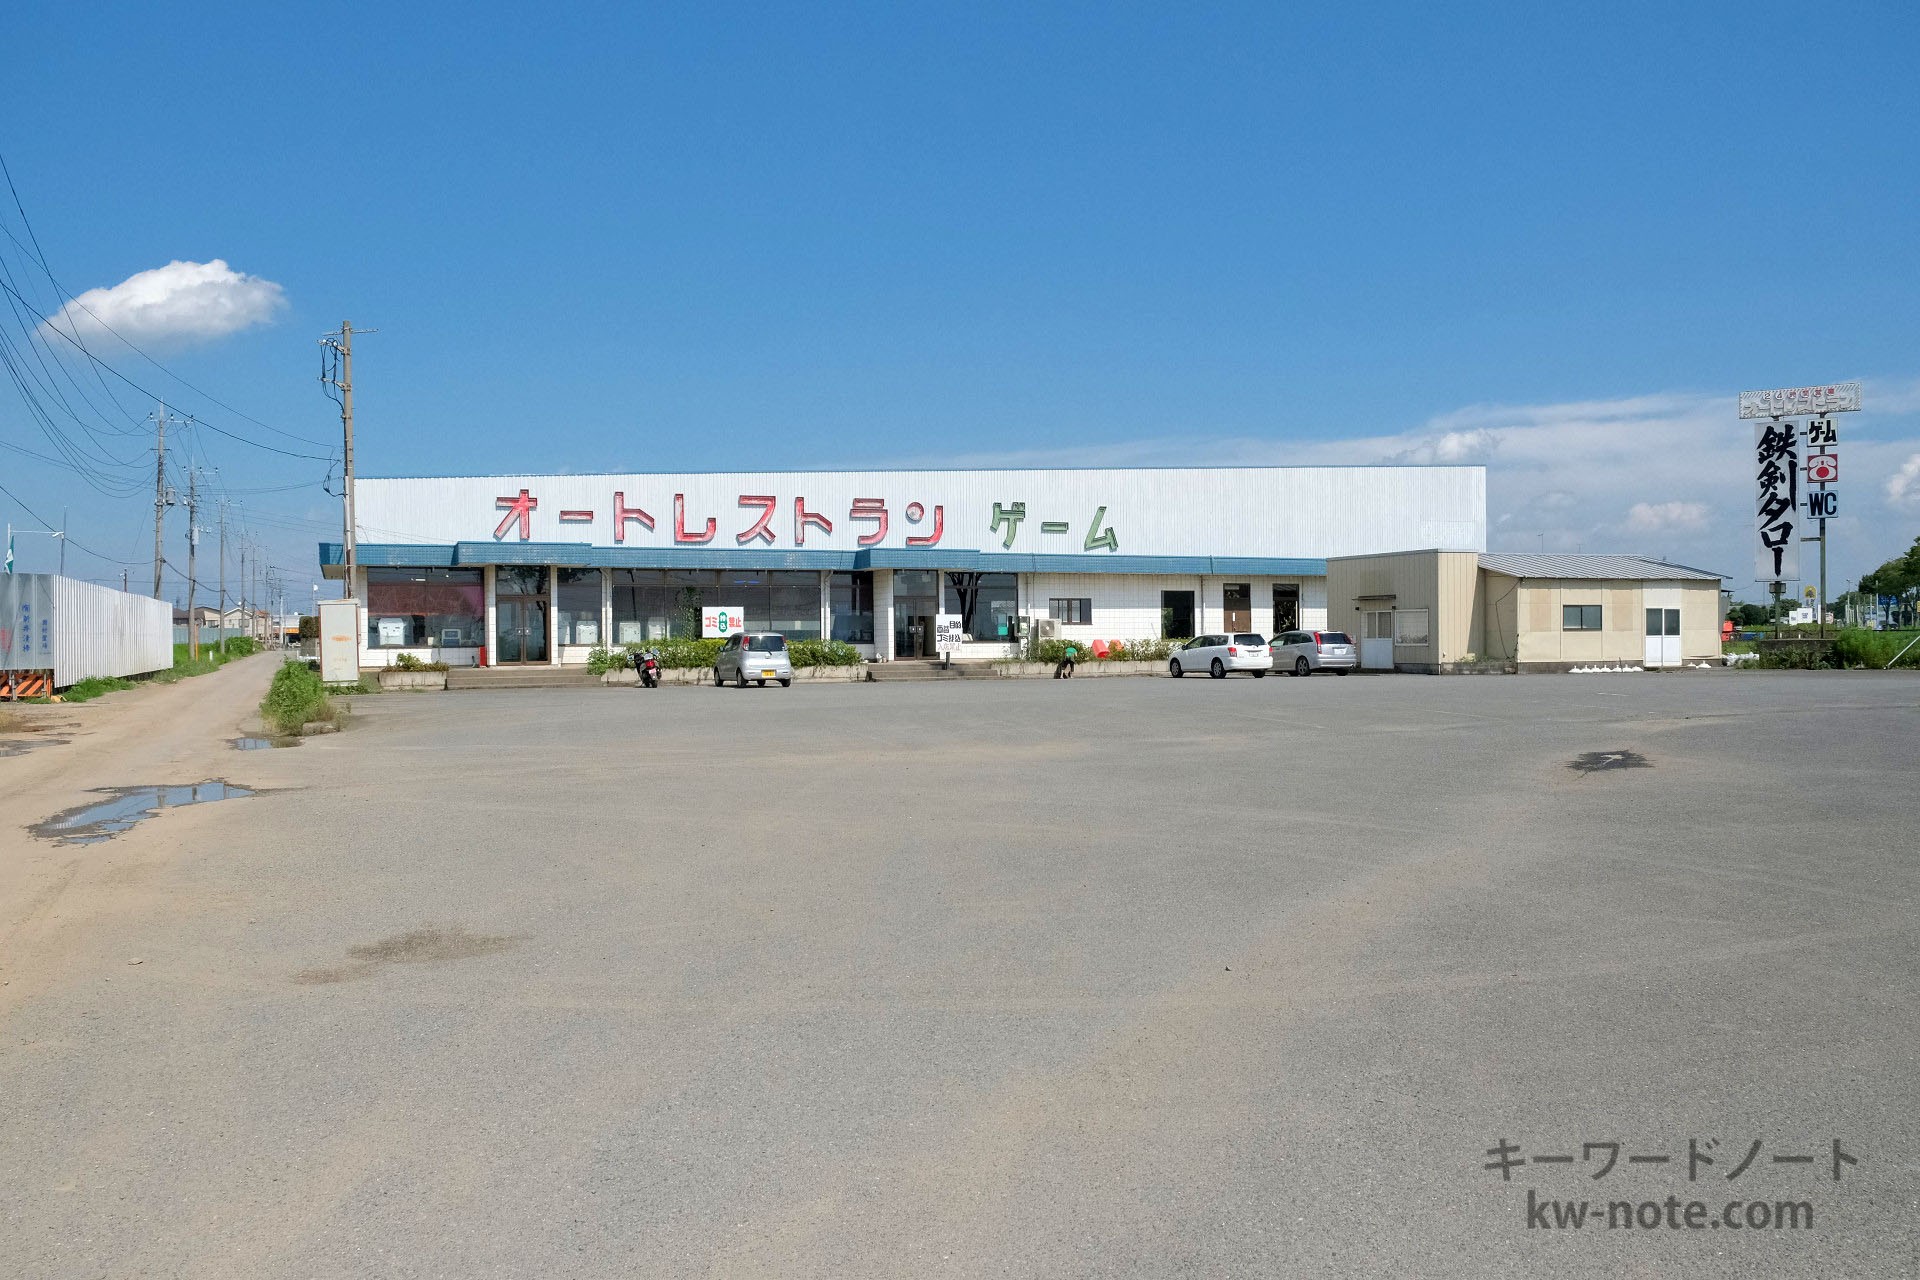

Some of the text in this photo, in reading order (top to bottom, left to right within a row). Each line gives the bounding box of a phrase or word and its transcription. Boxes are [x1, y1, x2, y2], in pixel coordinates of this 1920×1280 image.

[1808, 421, 1837, 443] ゲーム
[493, 489, 1118, 552] オートレストラン ゲーム
[1756, 424, 1797, 577] 鉄剣タロー
[1809, 492, 1837, 516] WC
